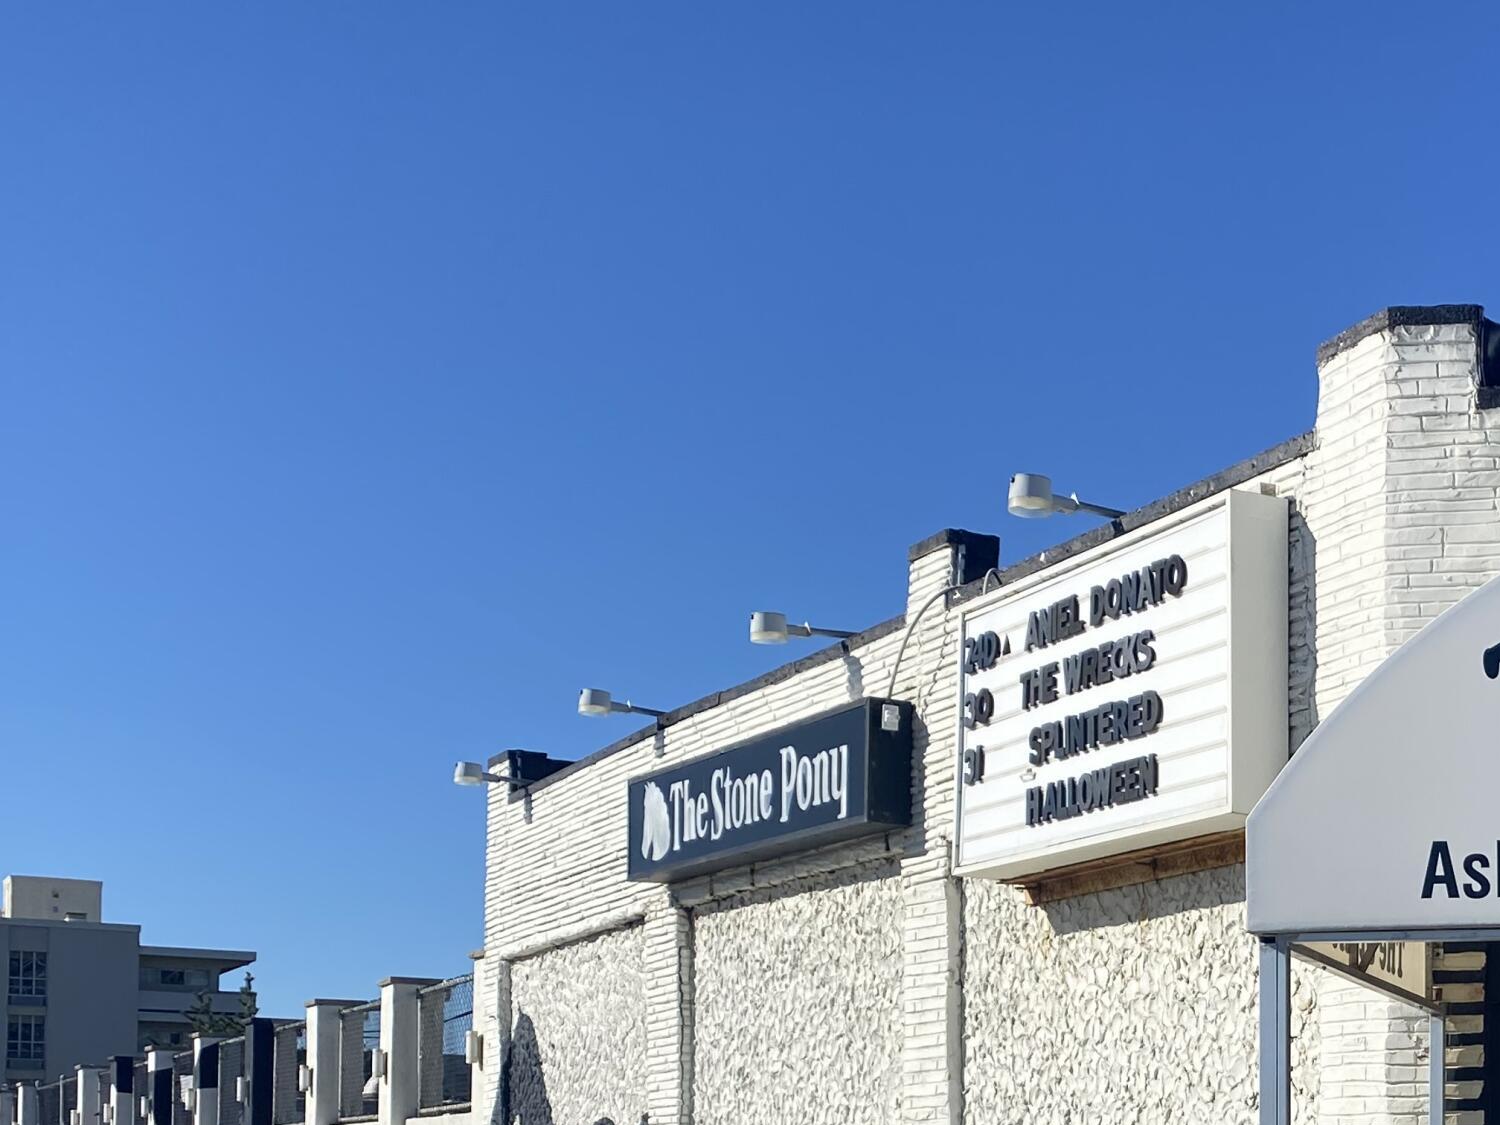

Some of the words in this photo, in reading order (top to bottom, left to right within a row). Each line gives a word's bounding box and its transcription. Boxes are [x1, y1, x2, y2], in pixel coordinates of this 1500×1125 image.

[1089, 554, 1188, 628] DONATO
[964, 688, 995, 729] 30
[1019, 661, 1060, 711] THE
[1062, 630, 1156, 696] WRECKS
[1028, 690, 1164, 767] SPLINTERED
[669, 779, 708, 850] The
[710, 766, 773, 841] Stone
[779, 745, 848, 823] Pony
[1024, 753, 1159, 827] HALLOWEEN
